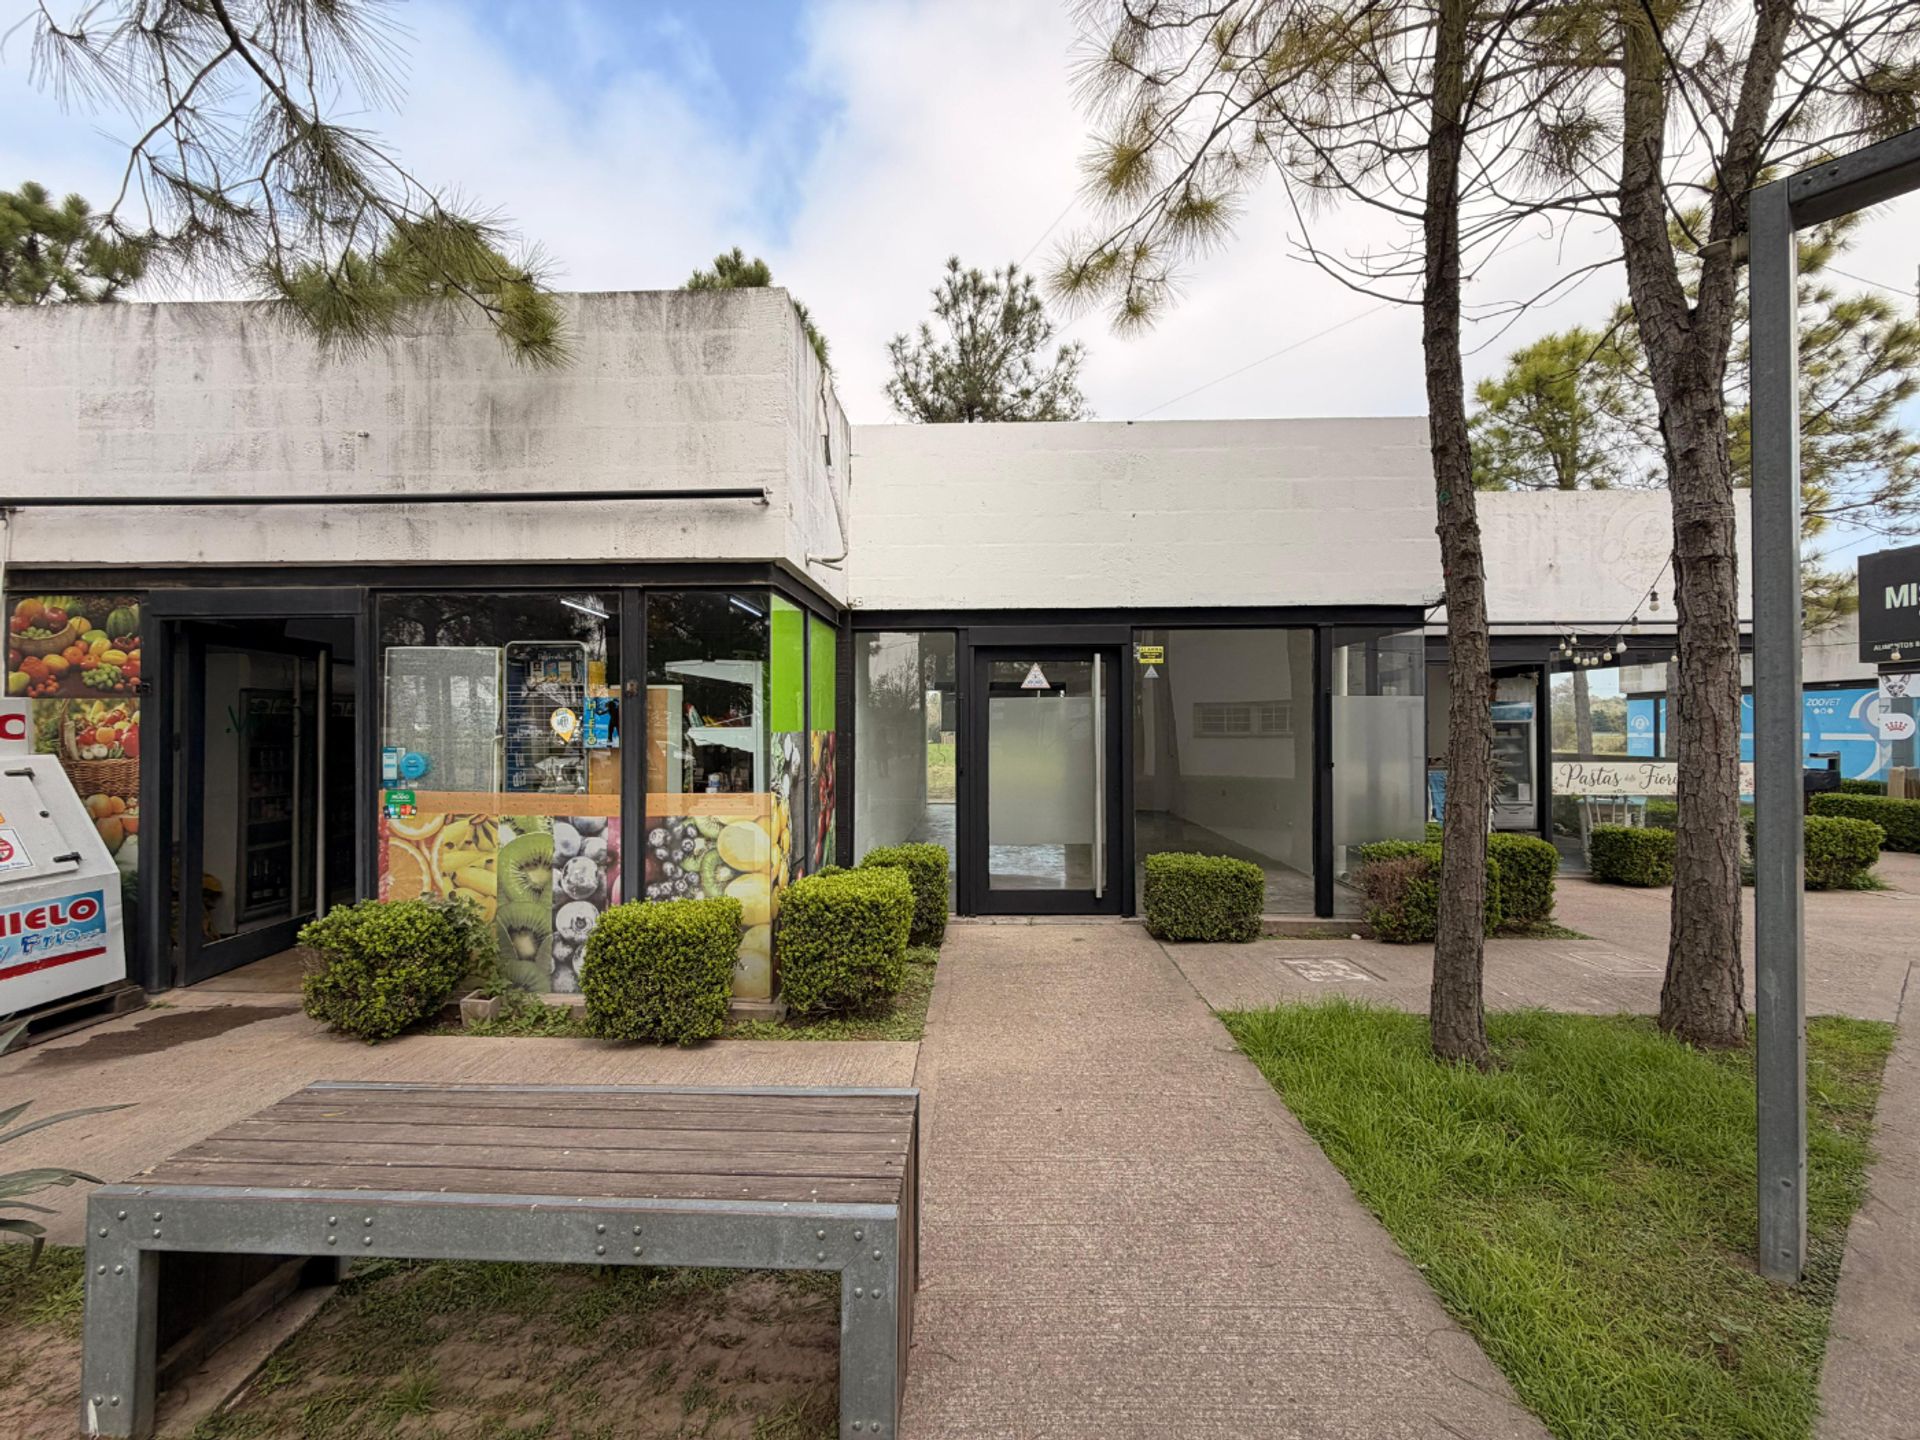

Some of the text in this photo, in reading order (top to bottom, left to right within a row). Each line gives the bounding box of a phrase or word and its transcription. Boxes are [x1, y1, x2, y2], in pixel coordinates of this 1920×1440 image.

[1885, 583, 1920, 609] MI
[1806, 697, 1841, 706] ZOOVET
[588, 700, 597, 746] HIELO
[1560, 764, 1621, 788] Pastas
